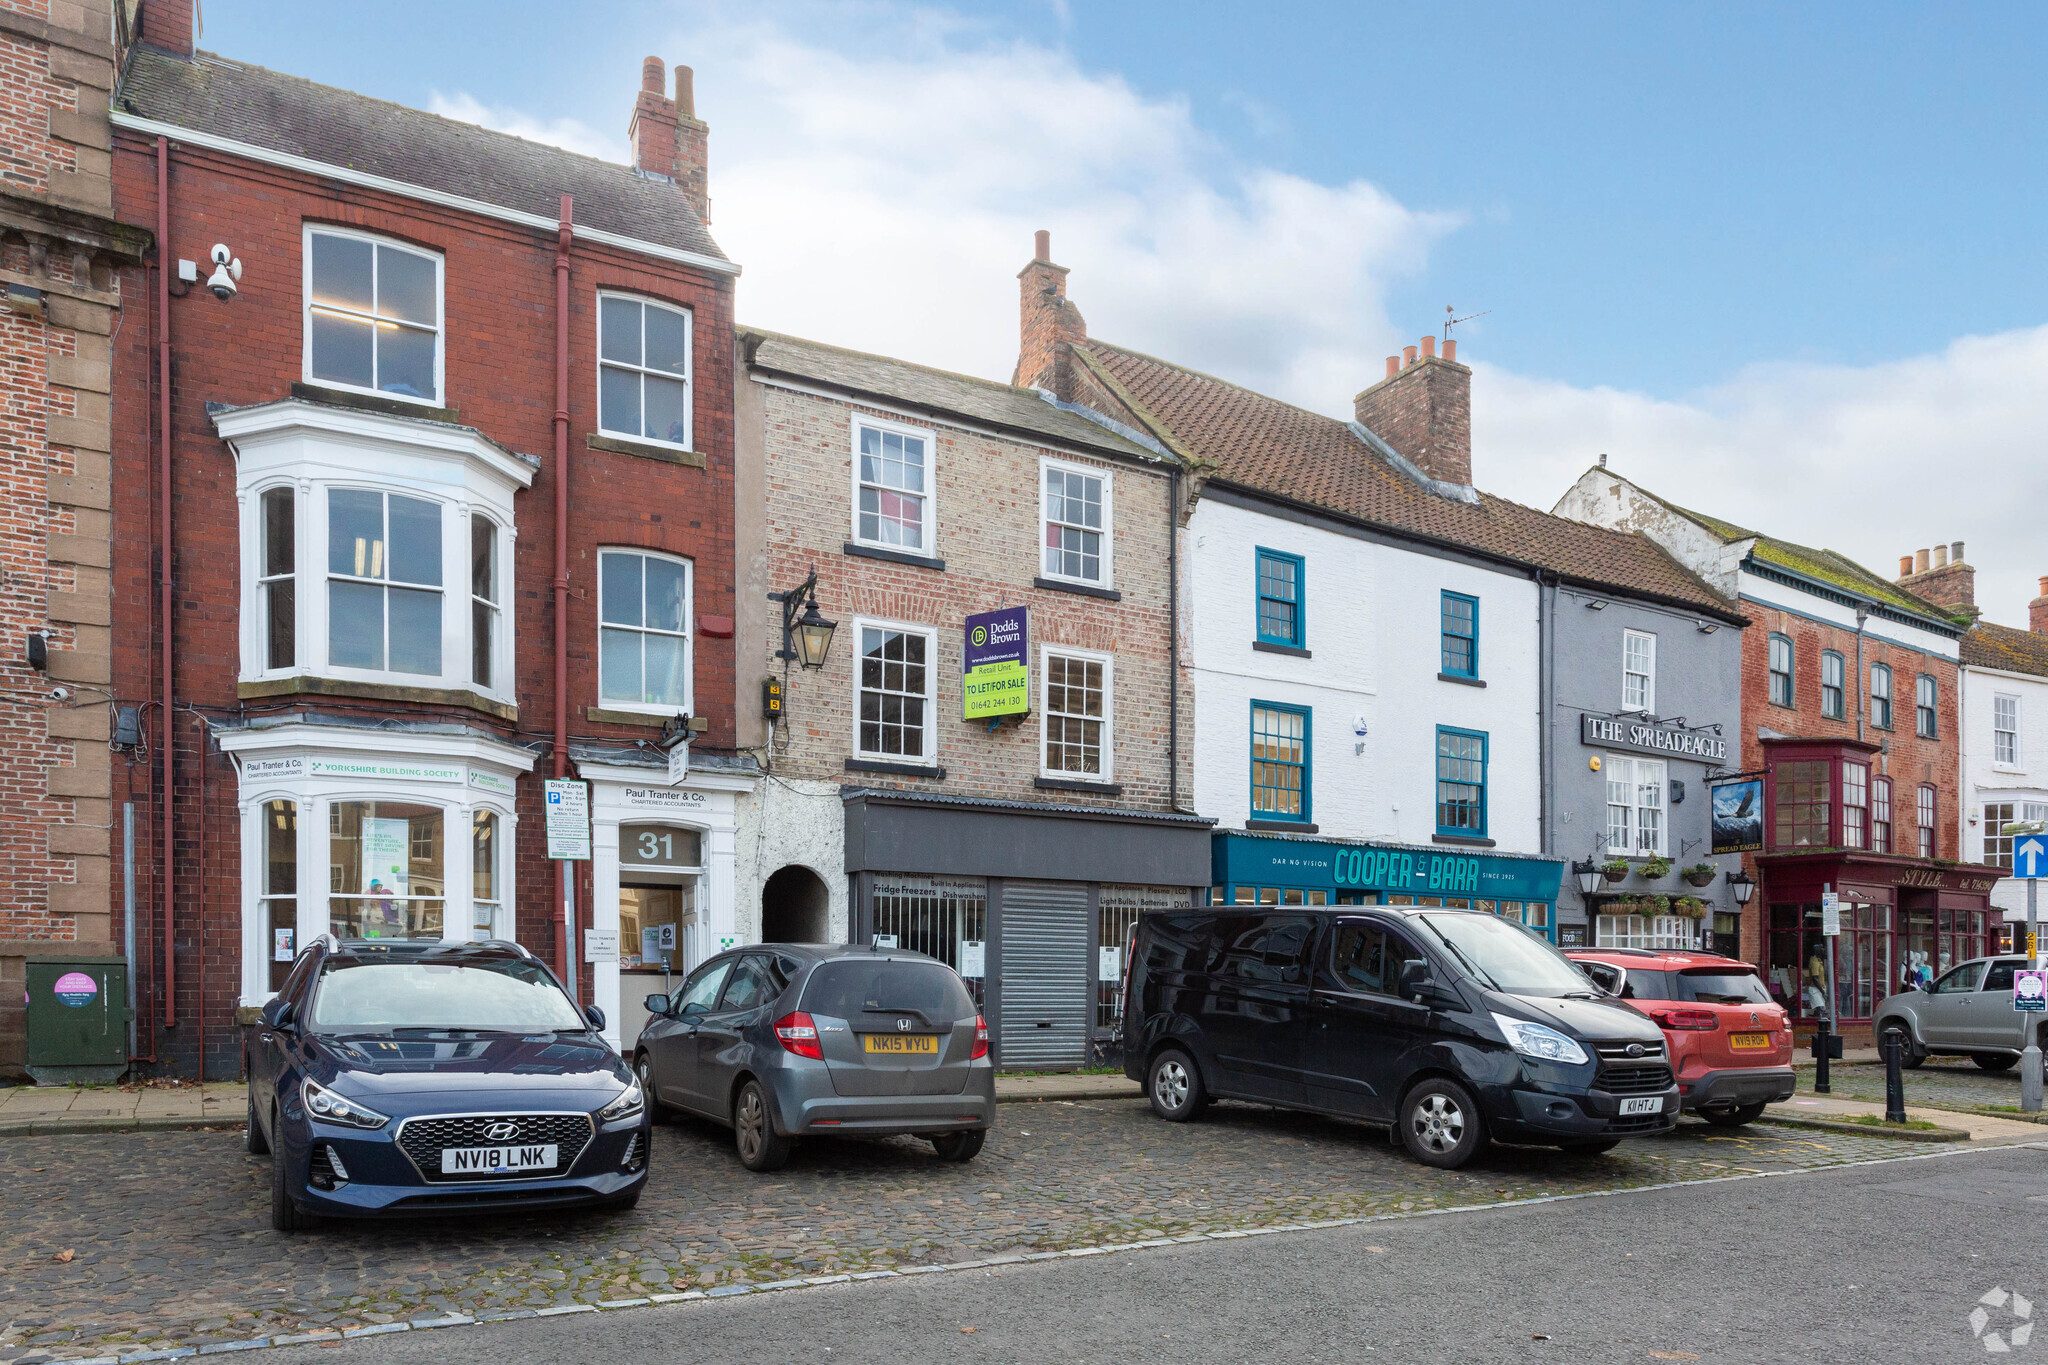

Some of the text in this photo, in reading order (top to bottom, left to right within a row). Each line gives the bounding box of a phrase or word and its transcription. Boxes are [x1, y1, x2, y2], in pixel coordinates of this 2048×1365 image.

[990, 619, 1019, 634] Dodds
[990, 632, 1020, 645] Brown
[971, 651, 1020, 663] www.doddsbrown.co.uk
[979, 664, 1012, 675] Retail Unit
[967, 684, 977, 695] TO
[1007, 677, 1025, 689] SALE
[970, 696, 1021, 710] 01642 244 130
[1587, 717, 1727, 759] THE SPREADEAGLE
[247, 759, 303, 771] Paul Tranter & Co.
[325, 764, 460, 778] YORKSHIRE BUILDING SOCIETY
[248, 769, 302, 779] CHARTERED ACCOUNTANTS
[550, 793, 559, 803] P
[625, 788, 707, 802] Paul Tranter & Co.
[631, 799, 702, 808] CHARTERED ACCOUNTANTS
[637, 831, 673, 860] 31
[1713, 842, 1762, 854] SPREAD EAGLE
[1303, 860, 1328, 868] VISION
[1333, 848, 1480, 892] COOPER & BARR
[874, 870, 935, 880] Washing Machines
[1482, 872, 1515, 881] SINCE 1925
[873, 883, 937, 896] Fridge Freezers
[952, 881, 986, 889] Appliances
[1174, 887, 1187, 895] LCD
[942, 890, 987, 900] Dishwashers
[1100, 897, 1117, 906] Light
[1140, 898, 1169, 907] Batteries
[1173, 900, 1190, 909] DVD
[1562, 934, 1576, 943] FOOD
[873, 1037, 930, 1051] NK15 WYU
[1735, 1035, 1750, 1046] NV19
[1637, 1099, 1655, 1111] HTJ
[455, 1147, 545, 1169] NV18 LNK
